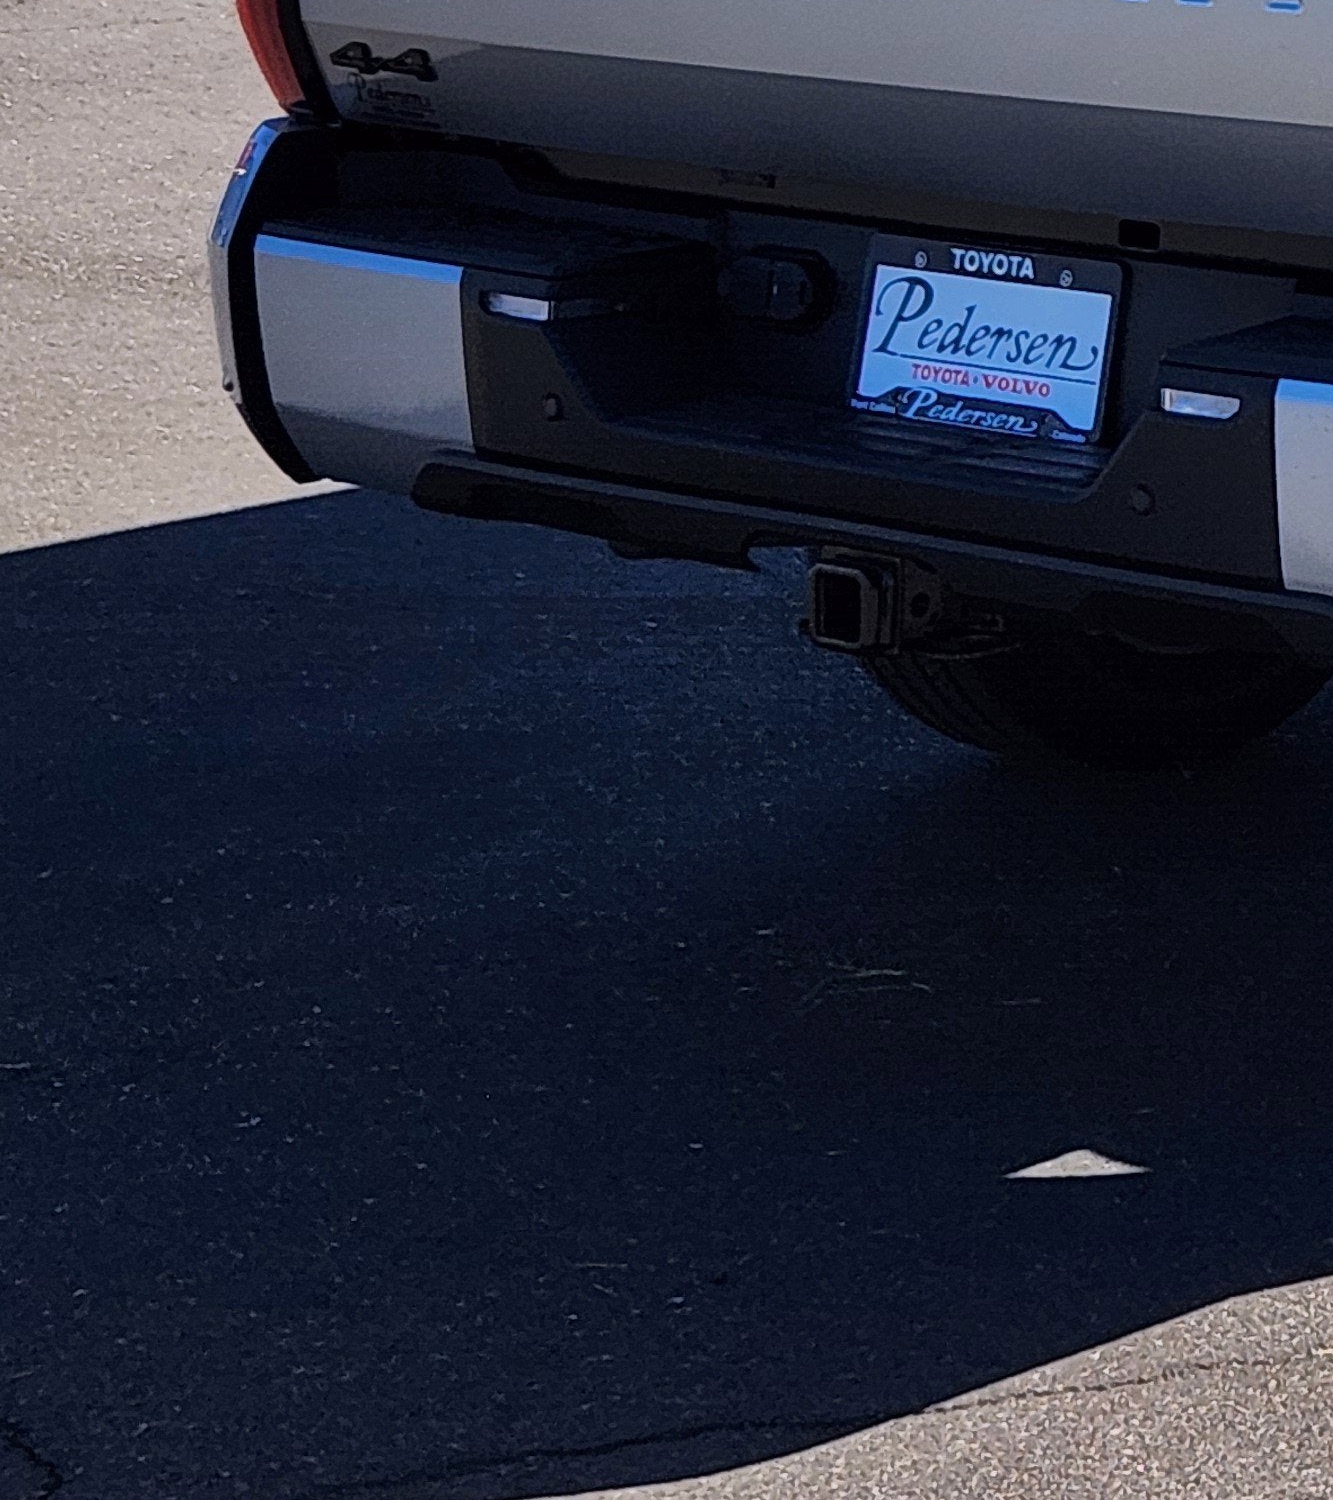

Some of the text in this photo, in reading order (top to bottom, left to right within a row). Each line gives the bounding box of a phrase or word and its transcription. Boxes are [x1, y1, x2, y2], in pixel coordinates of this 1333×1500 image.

[950, 248, 1035, 279] TOYOTA
[871, 276, 1100, 372] Pedersen
[911, 363, 1052, 398] TOYOTA VOLVO
[896, 386, 1039, 433] Pedersen
